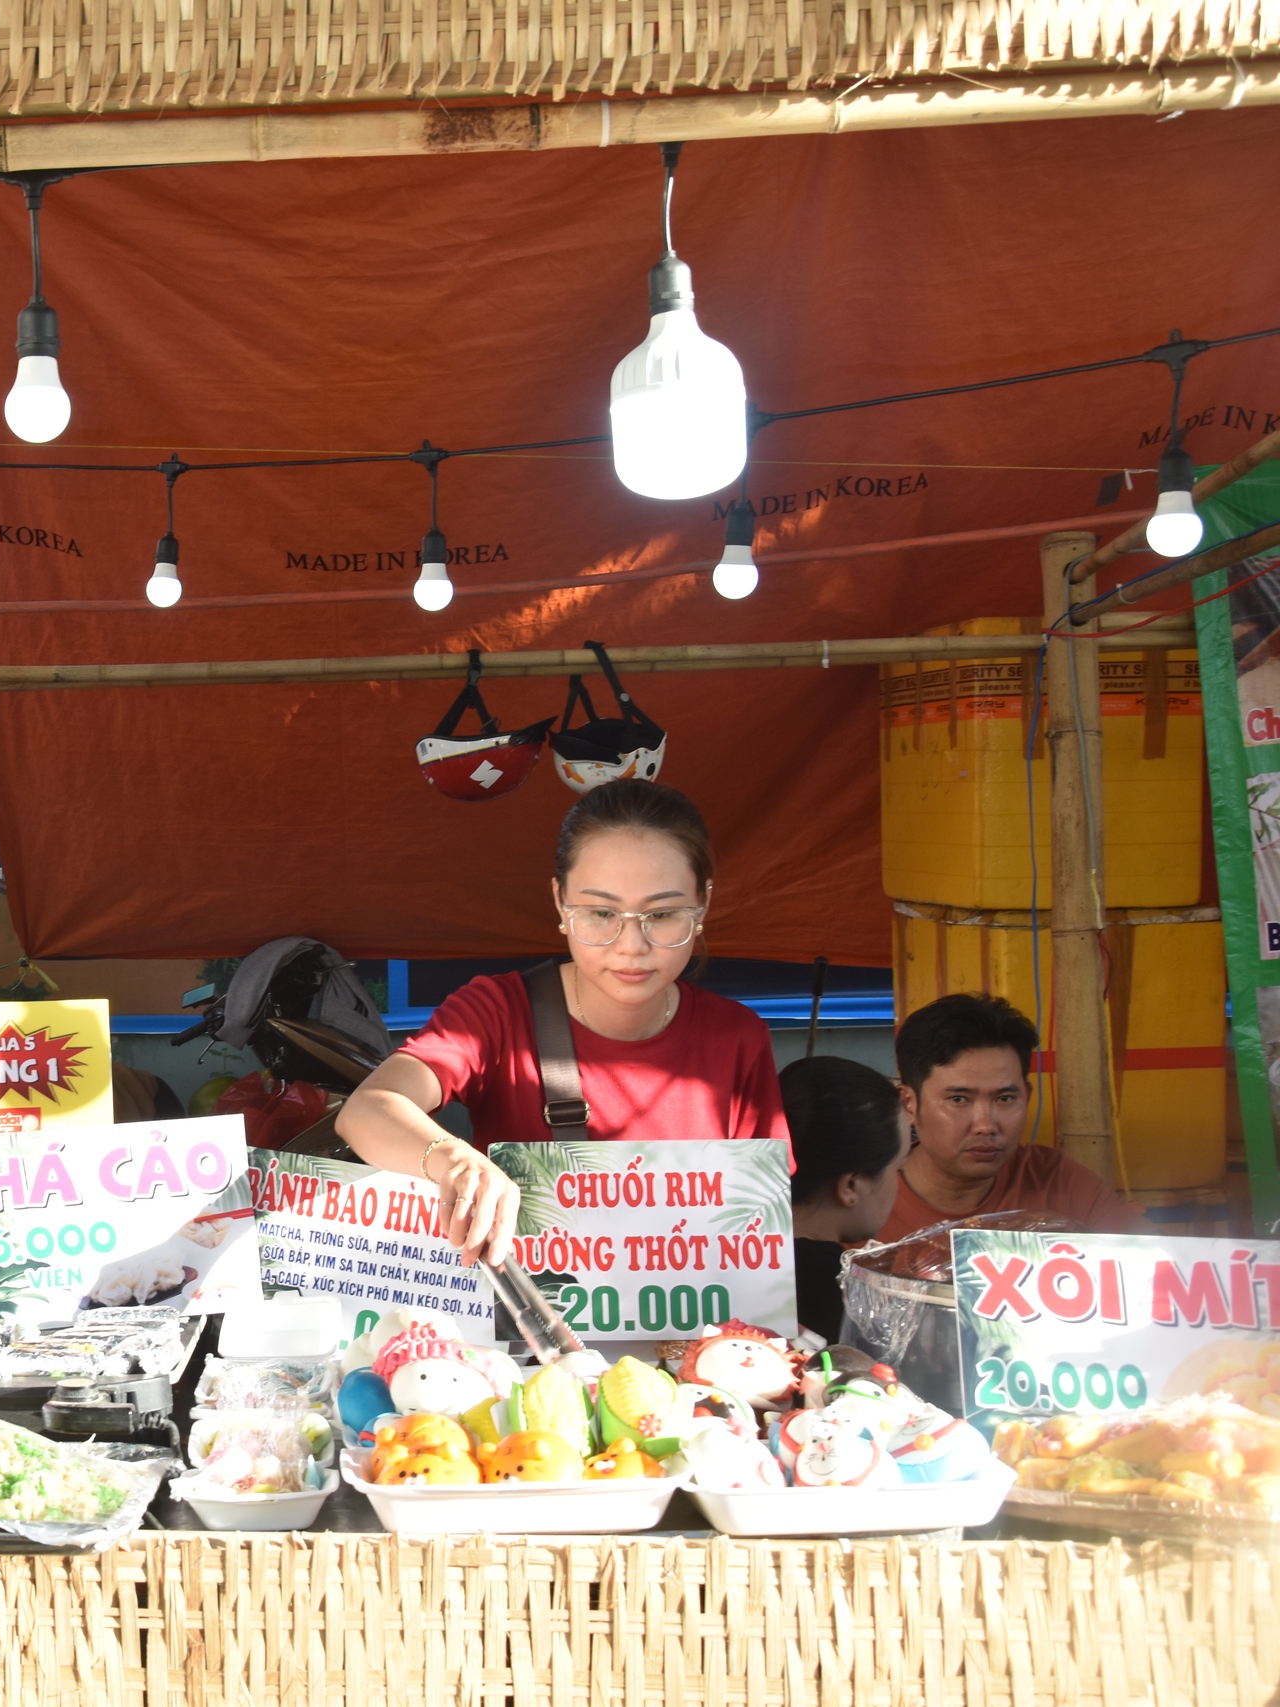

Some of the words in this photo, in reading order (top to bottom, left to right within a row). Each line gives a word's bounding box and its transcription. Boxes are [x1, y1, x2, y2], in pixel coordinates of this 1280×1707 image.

[1222, 405, 1257, 432] IN
[804, 483, 831, 511] IN
[834, 471, 929, 498] KOREA
[285, 551, 369, 572] MADE
[375, 551, 406, 571] IN
[24, 1036, 36, 1051] 5
[46, 1057, 59, 1082] 1
[98, 1130, 229, 1199] CẢO
[556, 1155, 657, 1209] CHUỐI
[664, 1171, 725, 1208] RIM
[248, 1159, 319, 1218] BÁNH
[322, 1180, 378, 1227] BAO
[257, 1221, 305, 1243] MATCHA,
[309, 1229, 345, 1248] TRỨNG
[348, 1234, 372, 1254] SỮA,
[376, 1240, 399, 1257] PHÔ
[401, 1244, 426, 1263] MAI,
[623, 1218, 709, 1272] THỐT
[717, 1217, 784, 1271] NỐT
[263, 1244, 285, 1260] SỮA
[314, 1254, 336, 1269] KIM
[339, 1257, 353, 1273] SA
[356, 1260, 377, 1276] TAN
[380, 1262, 410, 1283] CHẢY,
[413, 1270, 448, 1288] KHOAI
[450, 1274, 478, 1293] MÔN
[968, 1242, 1127, 1324] XÔI
[277, 1271, 309, 1290] CADÉ,
[312, 1275, 334, 1292] XÚC
[337, 1278, 364, 1297] XÍCH
[366, 1284, 389, 1301] PHÔ
[392, 1289, 414, 1306] MAI
[417, 1292, 439, 1310] KÉO
[467, 1300, 483, 1318] XÁ
[560, 1284, 731, 1332] 20.000
[975, 1357, 1148, 1411] 20.000
